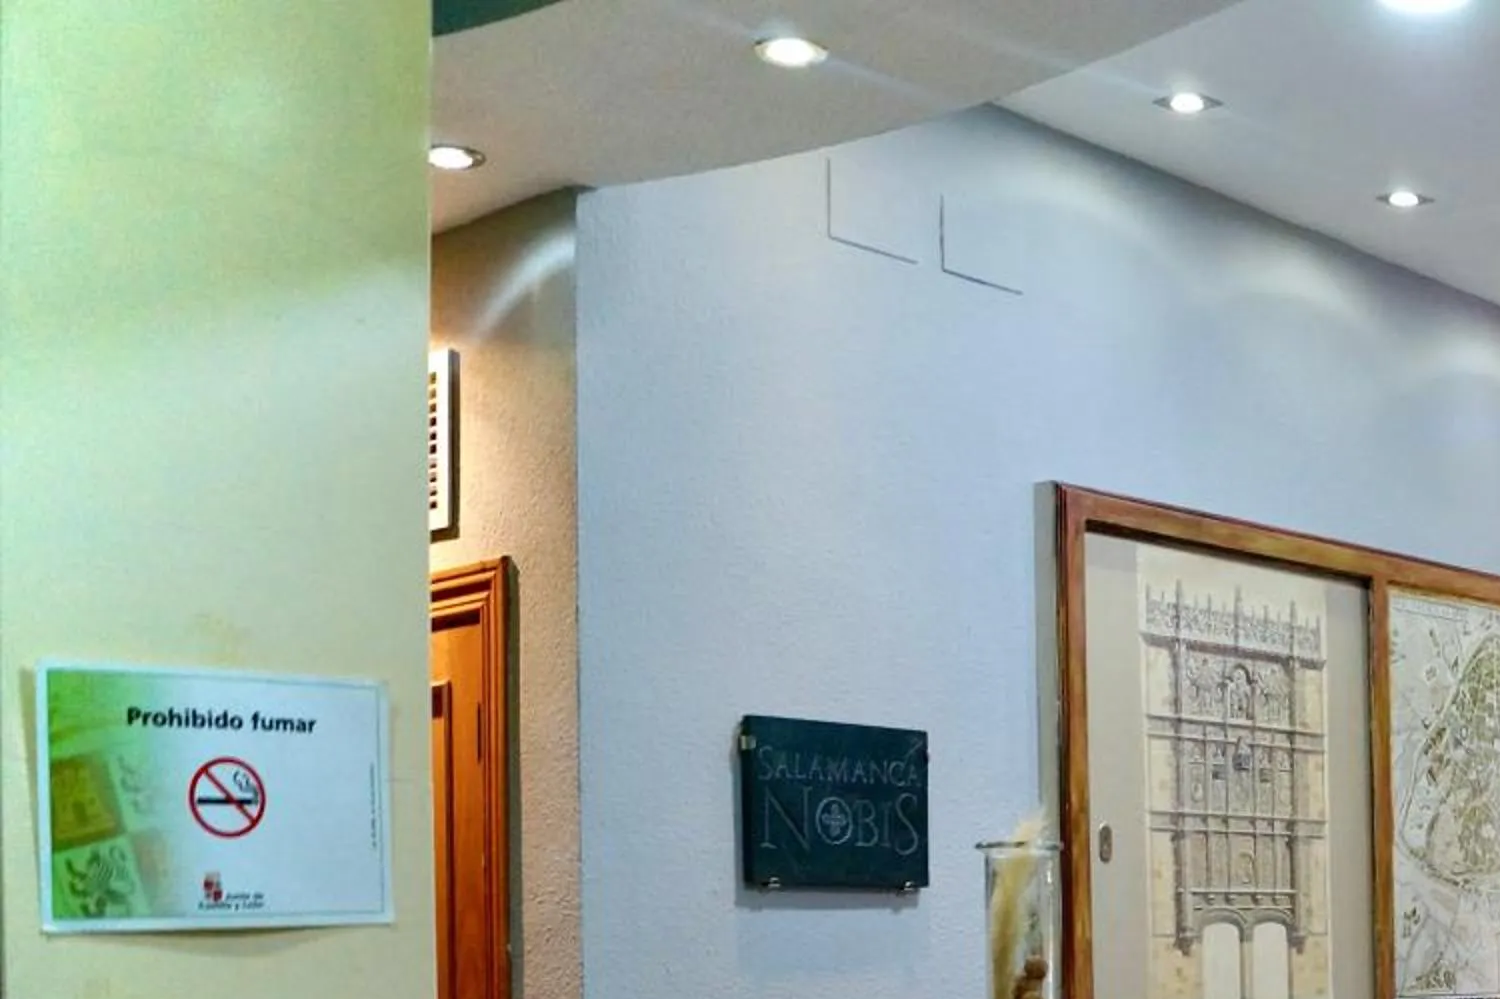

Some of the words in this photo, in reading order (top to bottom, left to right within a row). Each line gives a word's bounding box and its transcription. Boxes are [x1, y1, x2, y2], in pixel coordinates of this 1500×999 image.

[126, 706, 244, 730] Prohibido
[250, 710, 317, 733] fumar
[758, 745, 922, 787] SALAMANCA
[760, 785, 919, 855] NOBIS
